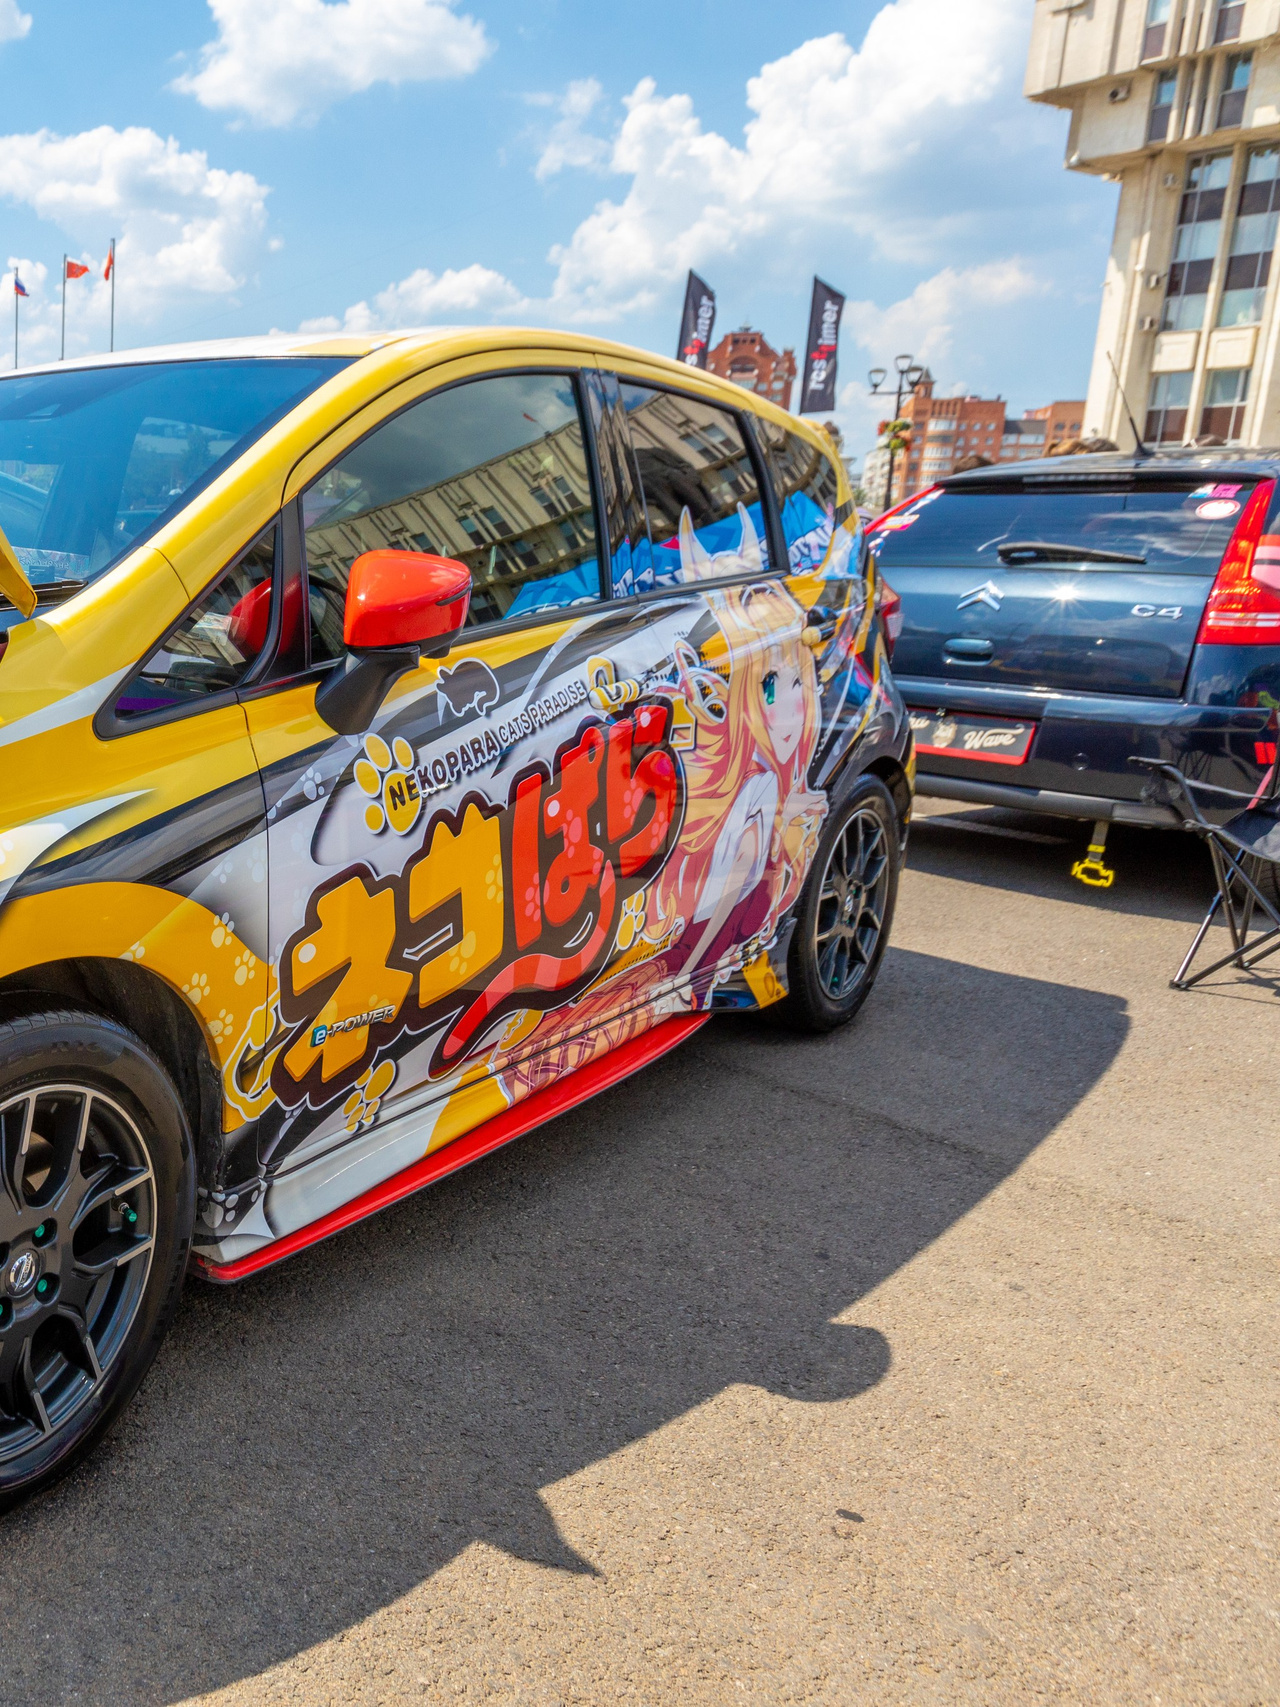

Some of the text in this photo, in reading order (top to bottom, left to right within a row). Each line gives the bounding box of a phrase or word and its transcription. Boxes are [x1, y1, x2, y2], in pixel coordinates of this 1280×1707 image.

[1130, 604, 1183, 620] C4
[388, 680, 586, 811] NEKOPARA CATS PARADISE
[963, 723, 1025, 750] Wave
[284, 705, 677, 1083] ネコぱら
[312, 1004, 396, 1047] e-POWER
